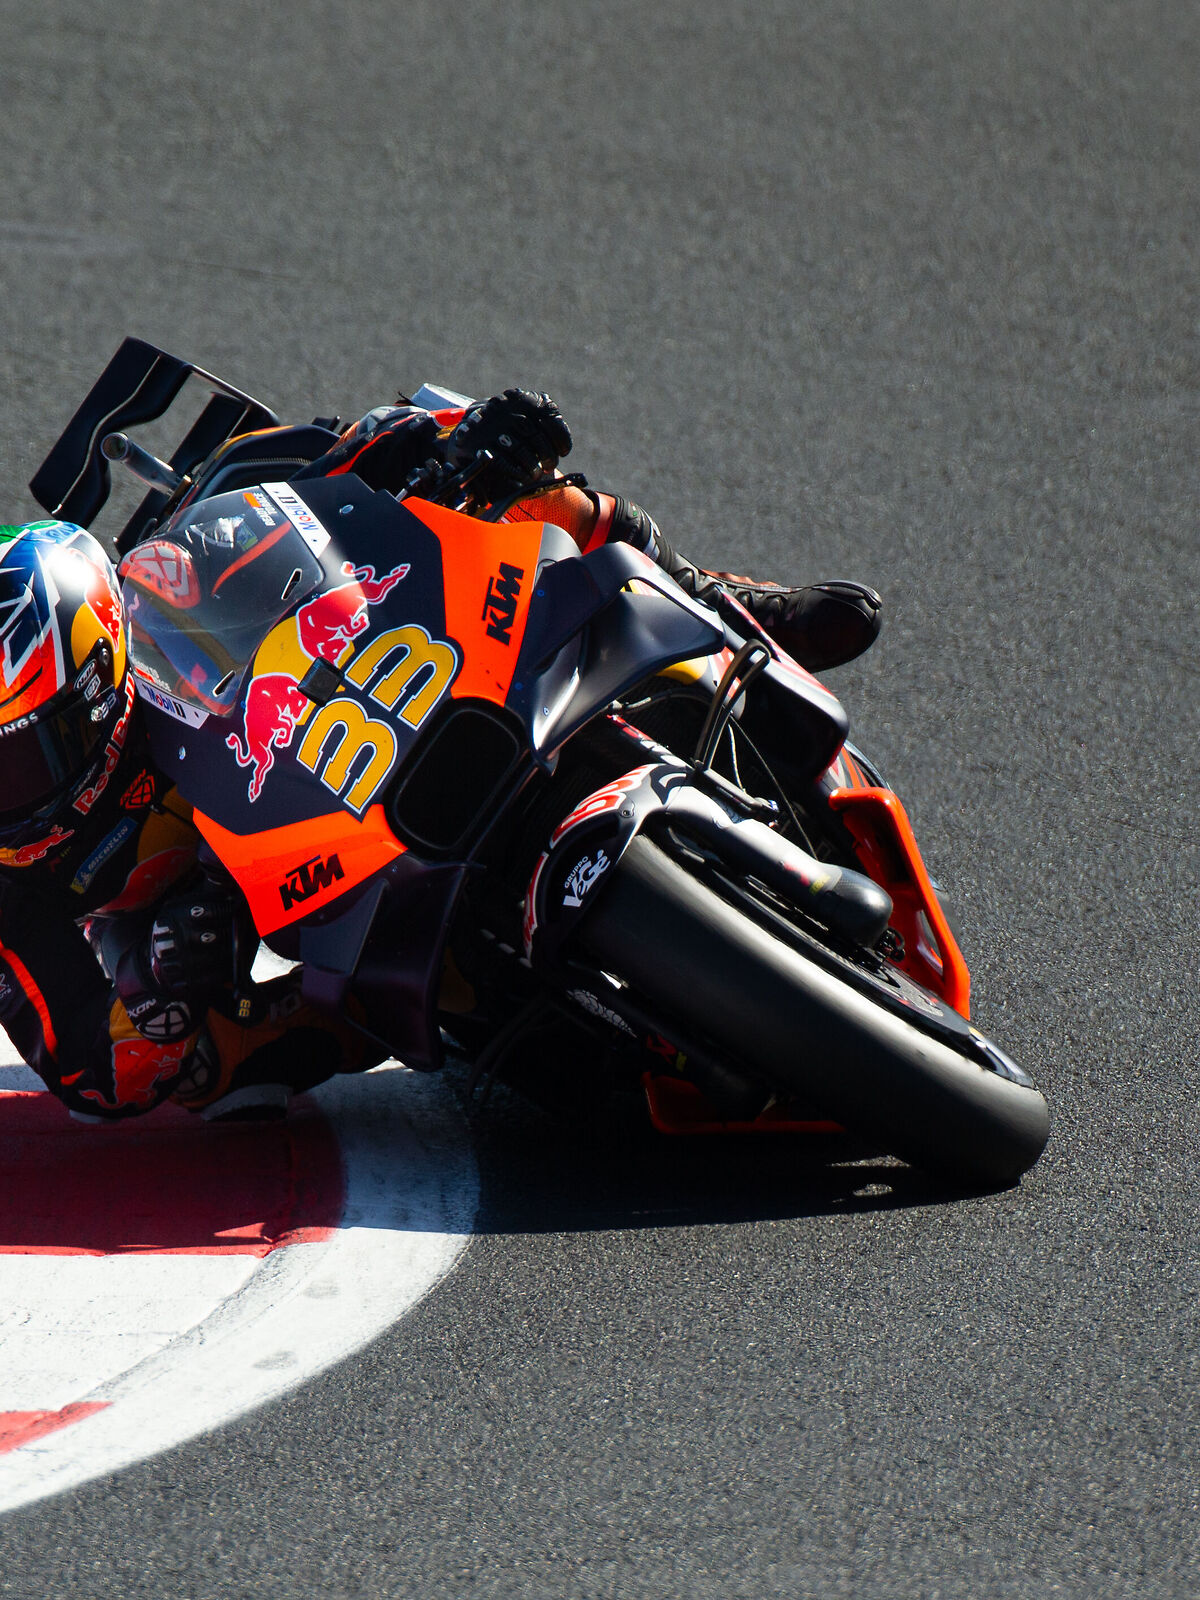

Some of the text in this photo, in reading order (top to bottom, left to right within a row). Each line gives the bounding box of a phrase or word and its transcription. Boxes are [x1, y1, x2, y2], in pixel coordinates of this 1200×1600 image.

[286, 505, 319, 531] Mobil
[483, 562, 524, 646] KTM
[147, 685, 176, 713] Mobil
[296, 624, 459, 815] 33
[72, 744, 120, 816] Red
[278, 853, 345, 910] KTM
[564, 855, 589, 890] GRUPPO
[238, 998, 253, 1017] 33
